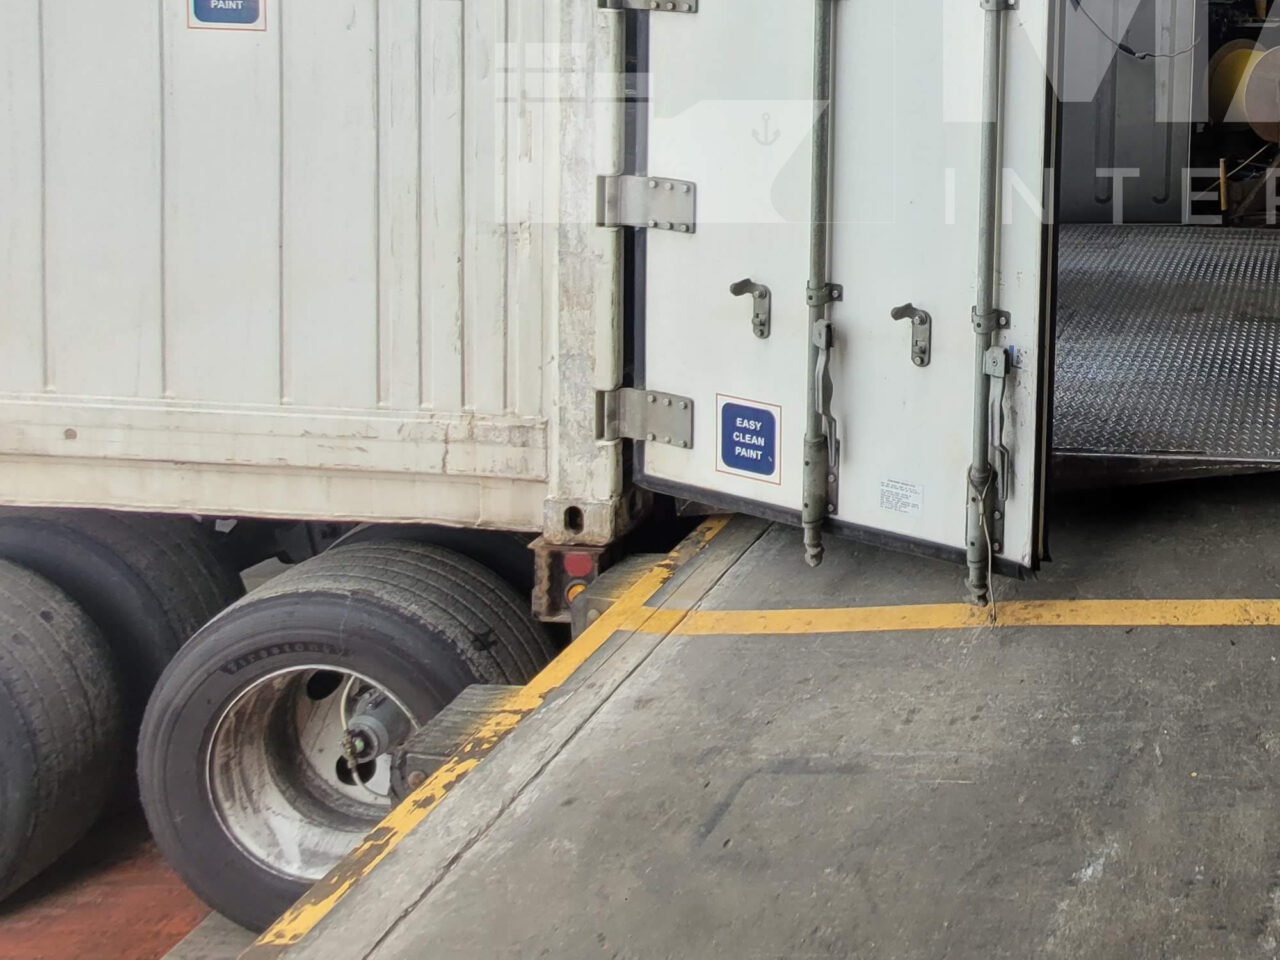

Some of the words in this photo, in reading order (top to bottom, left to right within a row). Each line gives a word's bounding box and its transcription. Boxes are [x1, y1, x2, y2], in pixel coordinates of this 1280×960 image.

[210, 0, 244, 10] PAINT
[736, 417, 762, 431] EASY
[733, 431, 765, 447] CLEAN
[735, 446, 763, 461] PAINT
